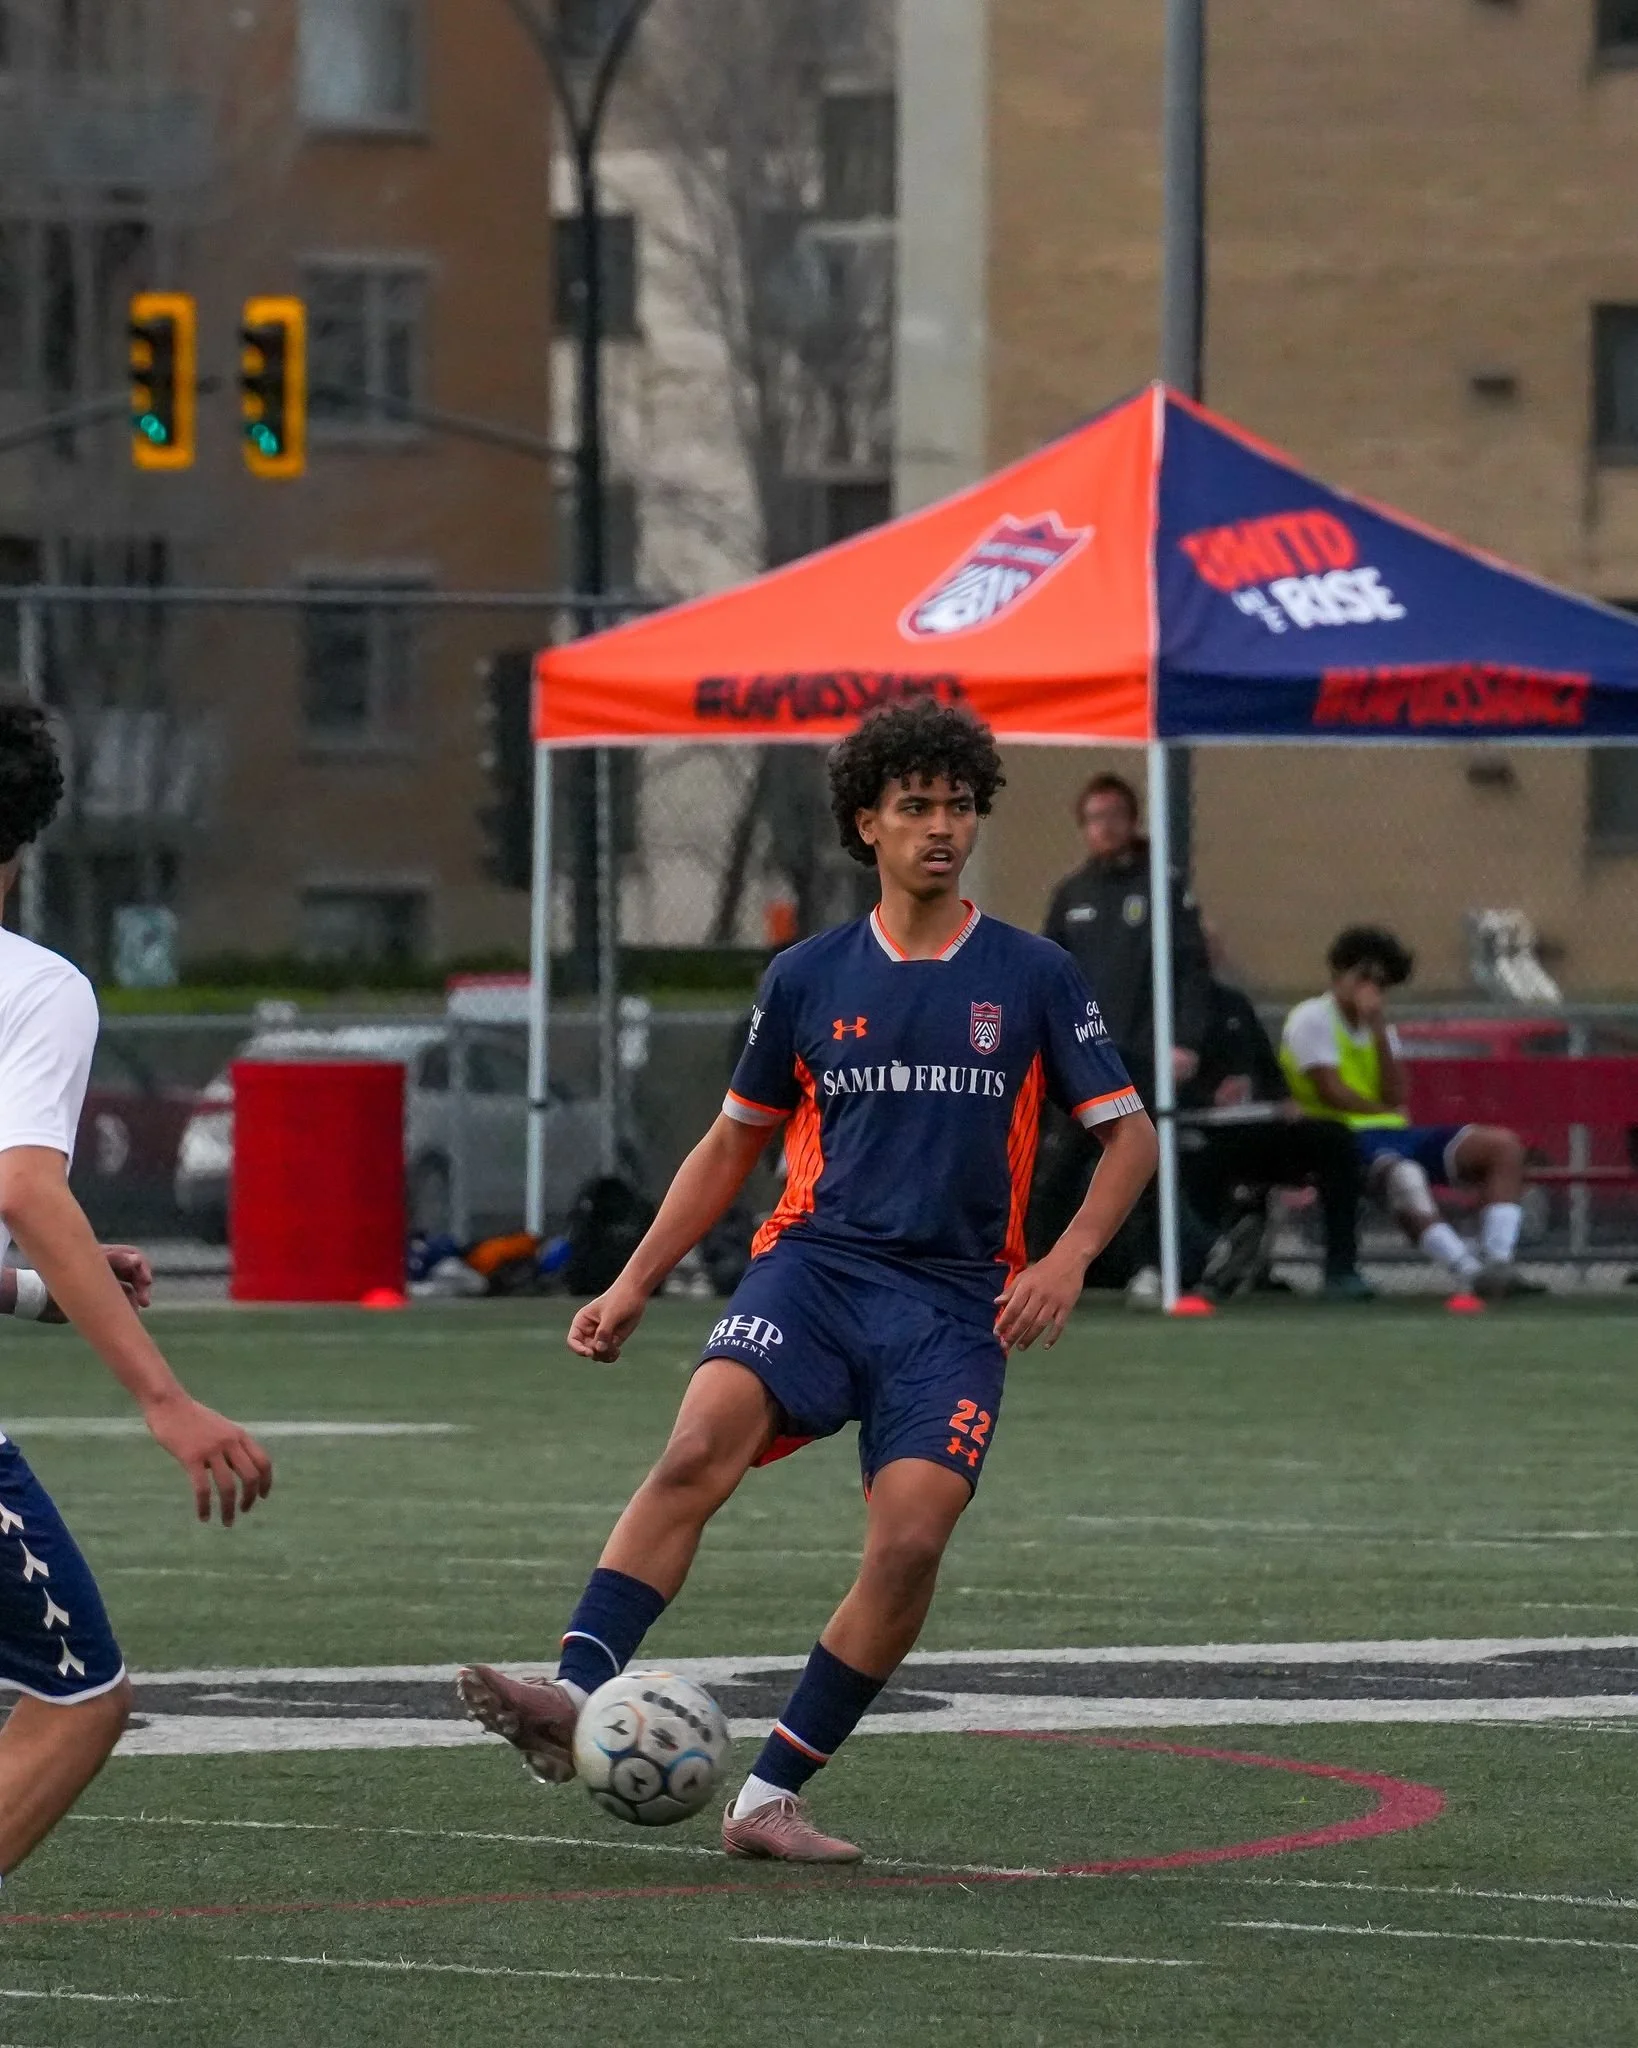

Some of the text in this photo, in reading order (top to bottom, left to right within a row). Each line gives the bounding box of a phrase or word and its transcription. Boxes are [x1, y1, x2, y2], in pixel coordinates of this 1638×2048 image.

[1269, 566, 1406, 630] RISE
[823, 1065, 1006, 1097] SAMI FRUITS
[706, 1314, 783, 1350] BHP
[709, 1338, 766, 1357] PAYMENT
[949, 1398, 991, 1447] 22
